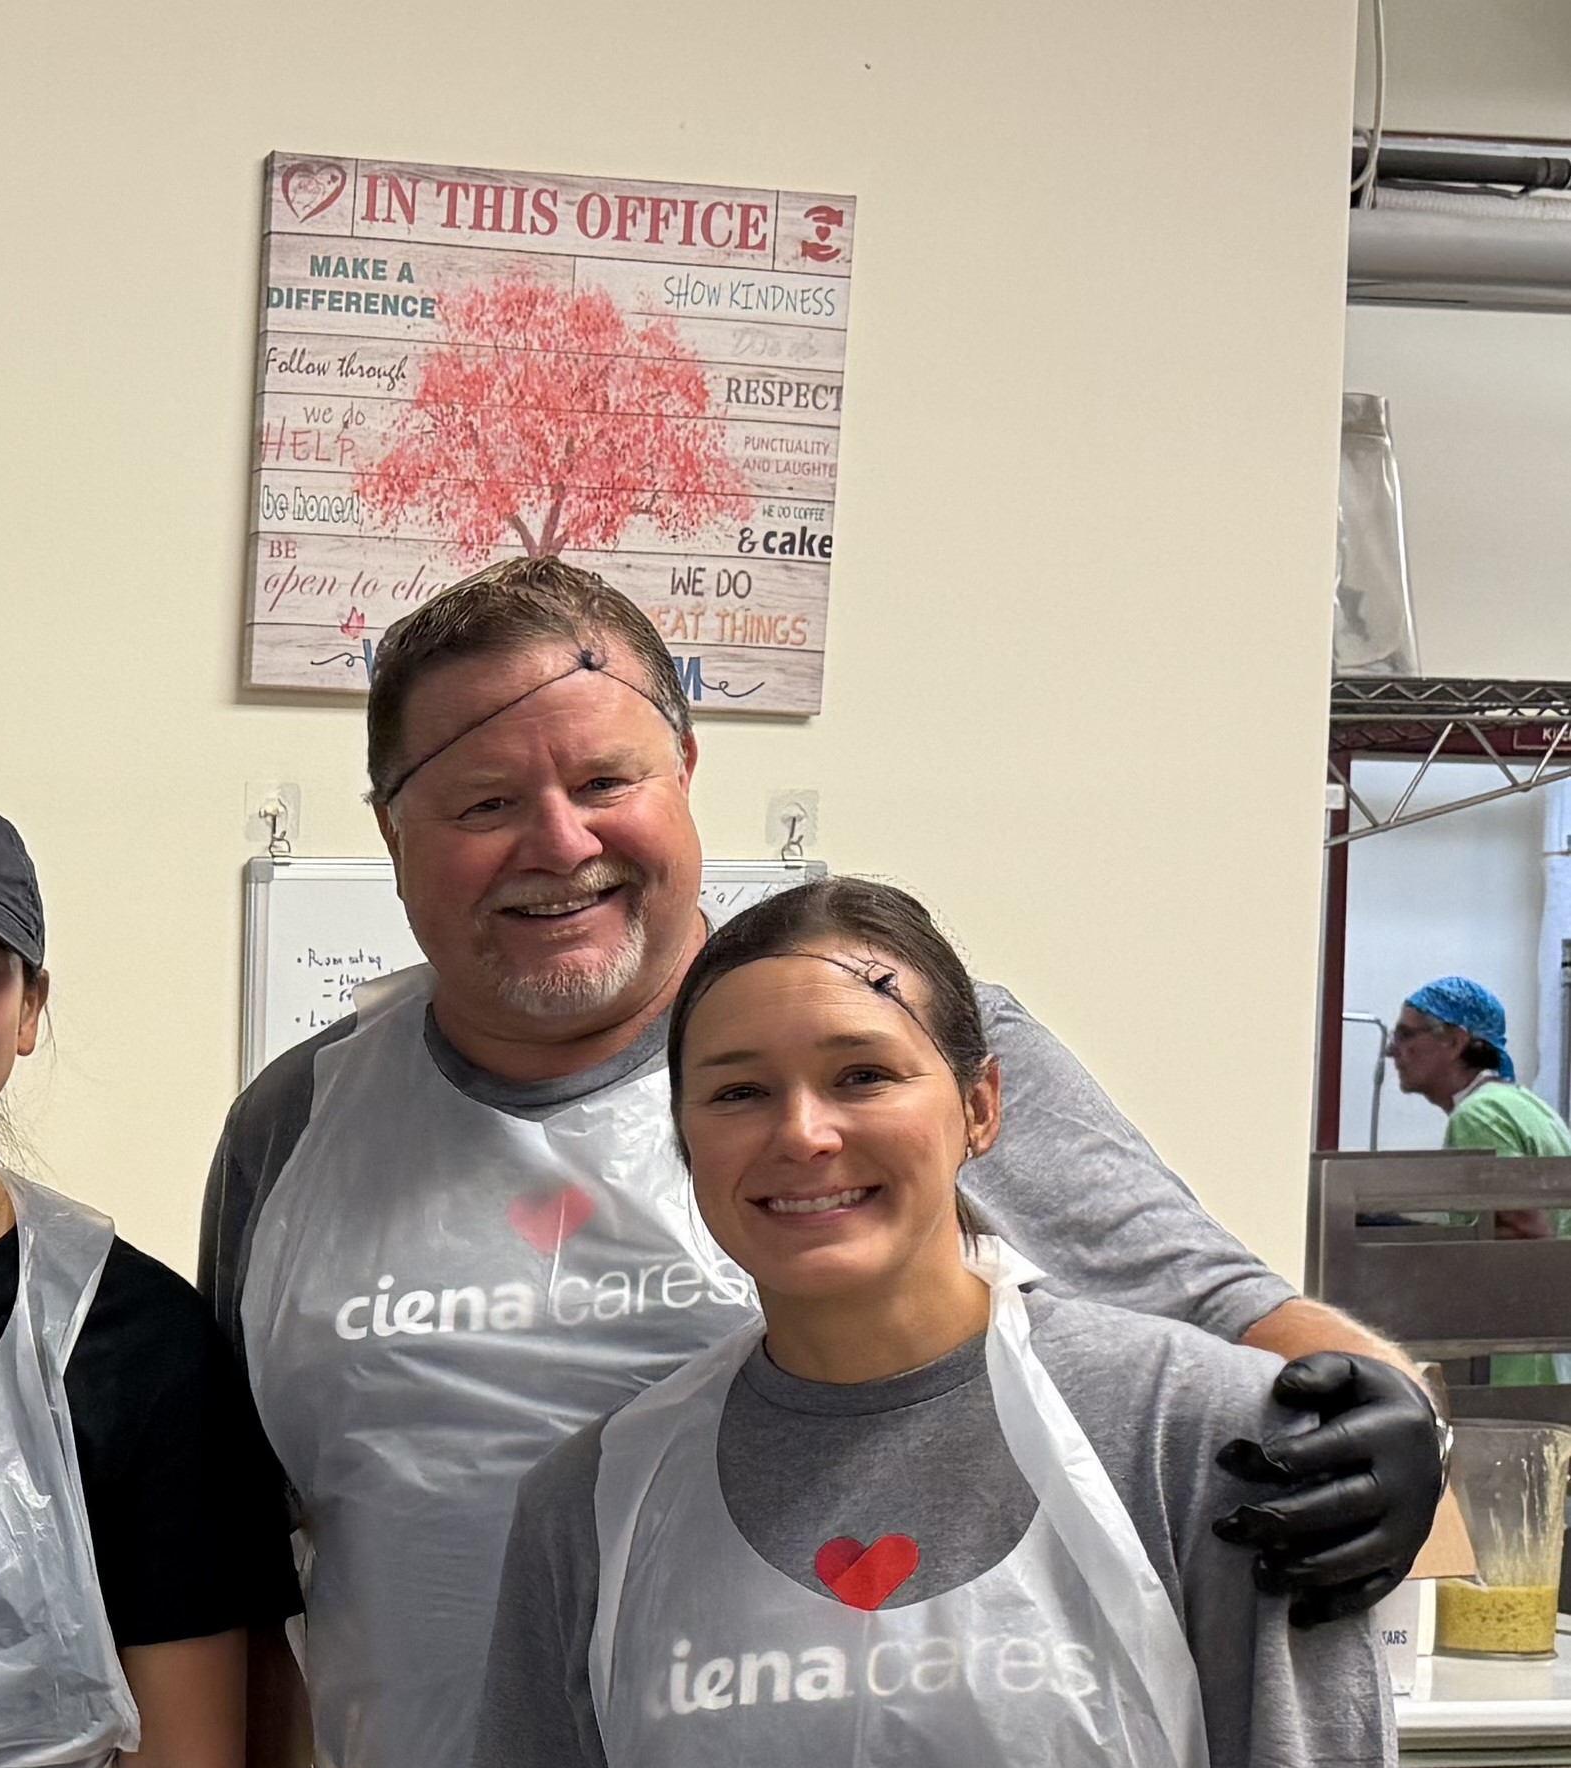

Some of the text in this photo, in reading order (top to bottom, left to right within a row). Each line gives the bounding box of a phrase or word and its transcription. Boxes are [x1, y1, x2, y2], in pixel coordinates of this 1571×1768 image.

[360, 174, 768, 251] IN THIS OFFICE
[309, 255, 415, 283] MAKE A
[267, 287, 436, 319] DIFFERENCE
[664, 273, 835, 316] SHOW KINDNESS
[264, 347, 407, 391] Follow through
[725, 377, 843, 411] RESPECT
[261, 417, 355, 466] HELP
[744, 436, 830, 456] PUNCTUALITY
[742, 460, 837, 478] AND LAUGHTE
[262, 485, 360, 523] be honest
[762, 505, 825, 521] WE DO COFFEE
[269, 540, 297, 558] BE
[738, 526, 832, 558] & cake
[264, 565, 446, 612] open to cha
[670, 566, 752, 599] WE DO
[652, 607, 808, 646] EAT THINGS
[334, 1257, 750, 1341] ciena cares
[867, 1635, 1100, 1698] cares
